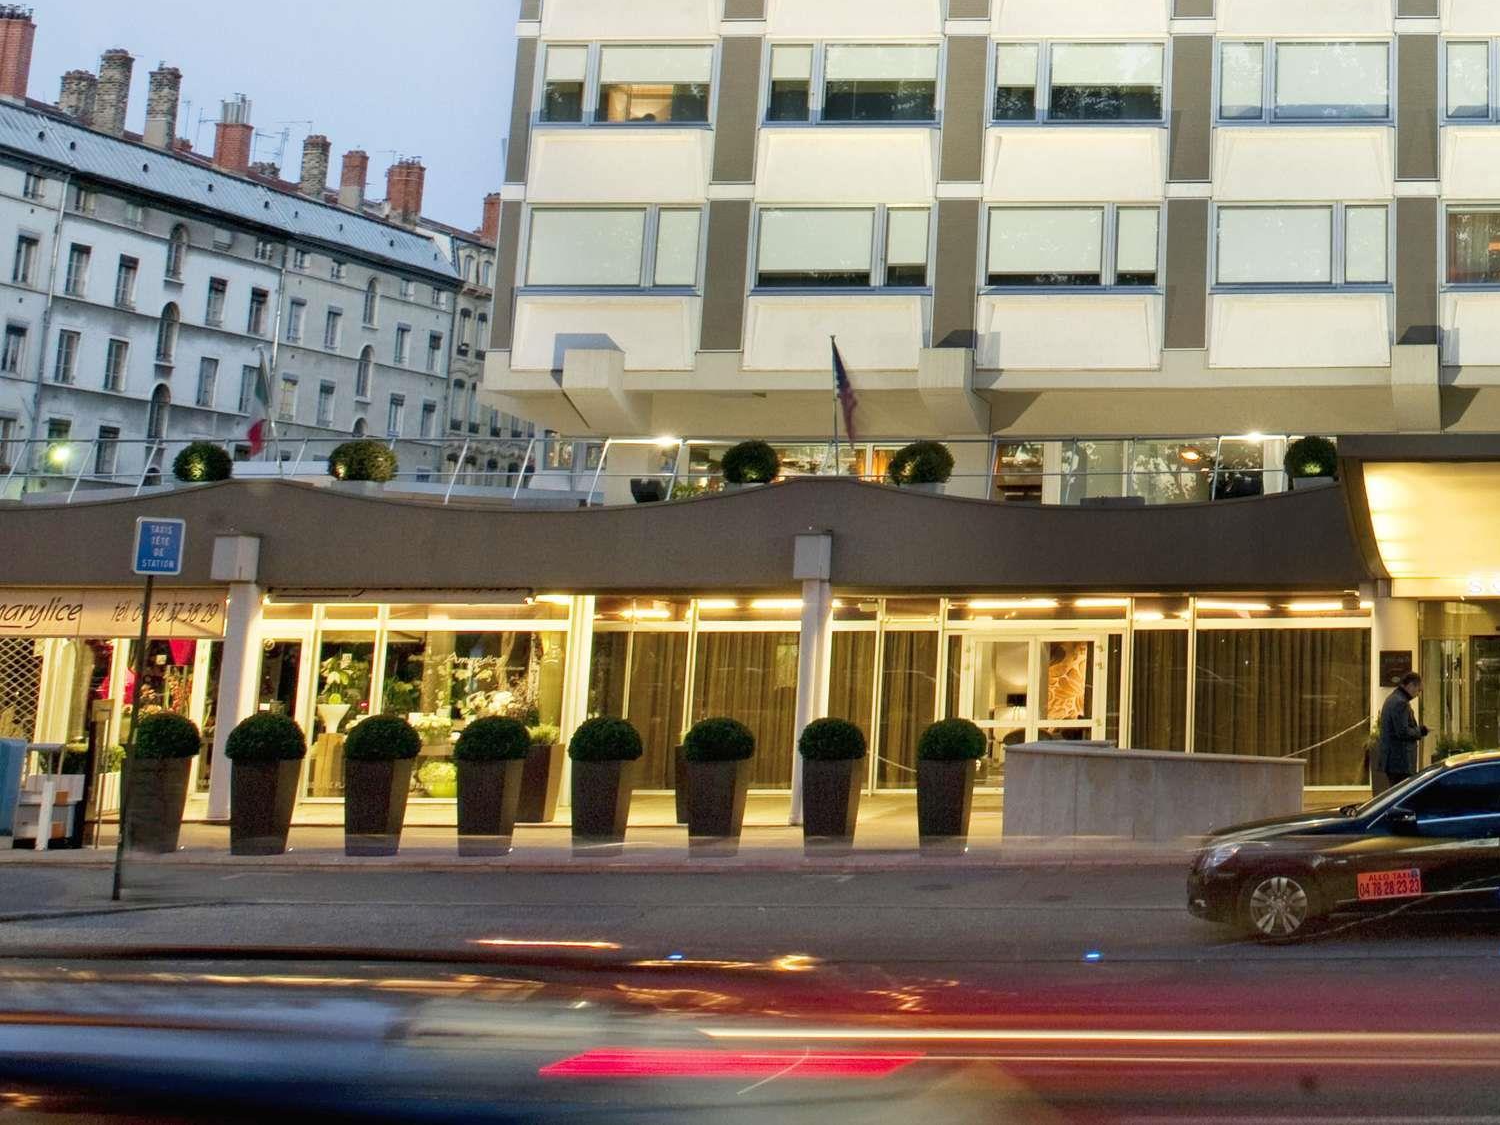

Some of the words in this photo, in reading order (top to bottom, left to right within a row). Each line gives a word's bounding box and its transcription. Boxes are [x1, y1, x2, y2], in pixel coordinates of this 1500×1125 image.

[142, 559, 175, 569] STATION
[201, 602, 219, 624] 29
[1368, 873, 1390, 882] ALLO
[1360, 882, 1370, 898] 04
[1372, 881, 1383, 897] 78
[1384, 880, 1395, 895] 28
[1397, 879, 1408, 894] 23
[1409, 877, 1420, 893] 23
